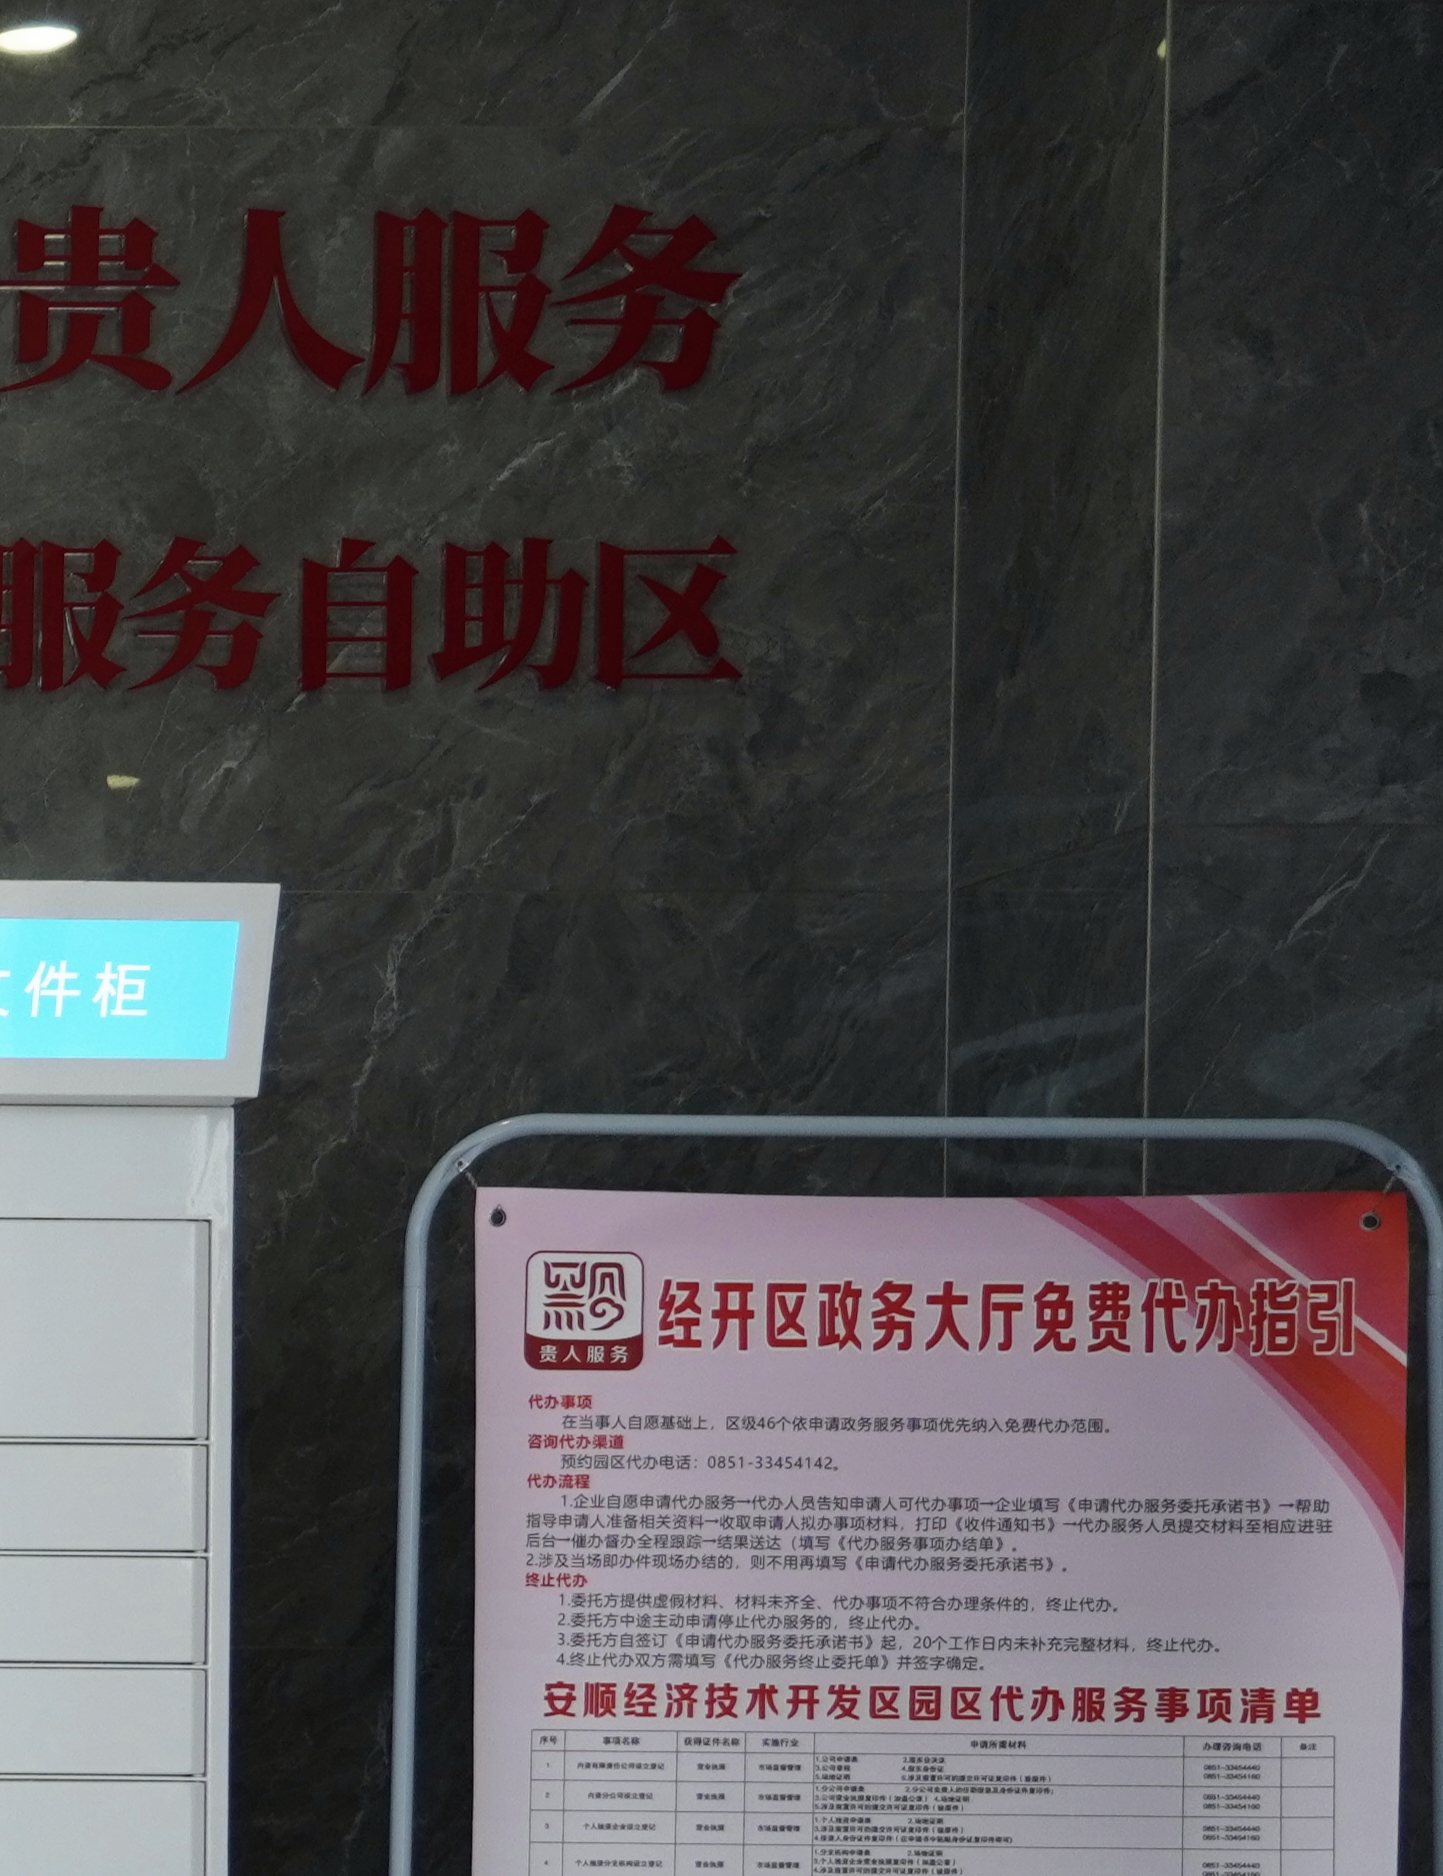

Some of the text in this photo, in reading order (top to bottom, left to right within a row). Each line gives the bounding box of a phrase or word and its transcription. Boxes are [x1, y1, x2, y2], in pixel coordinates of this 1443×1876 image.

[658, 1277, 1357, 1358] 经开区政务大厅免费代办指引
[539, 1344, 629, 1365] 贵人服务
[528, 1394, 593, 1410] 代办事项
[527, 1434, 625, 1450] 咨询代办渠道
[526, 1474, 591, 1489] 代办流程
[525, 1573, 587, 1588] 终止代办
[544, 1681, 1322, 1724] 安顺经济技术开发区园区代办服务事项清单
